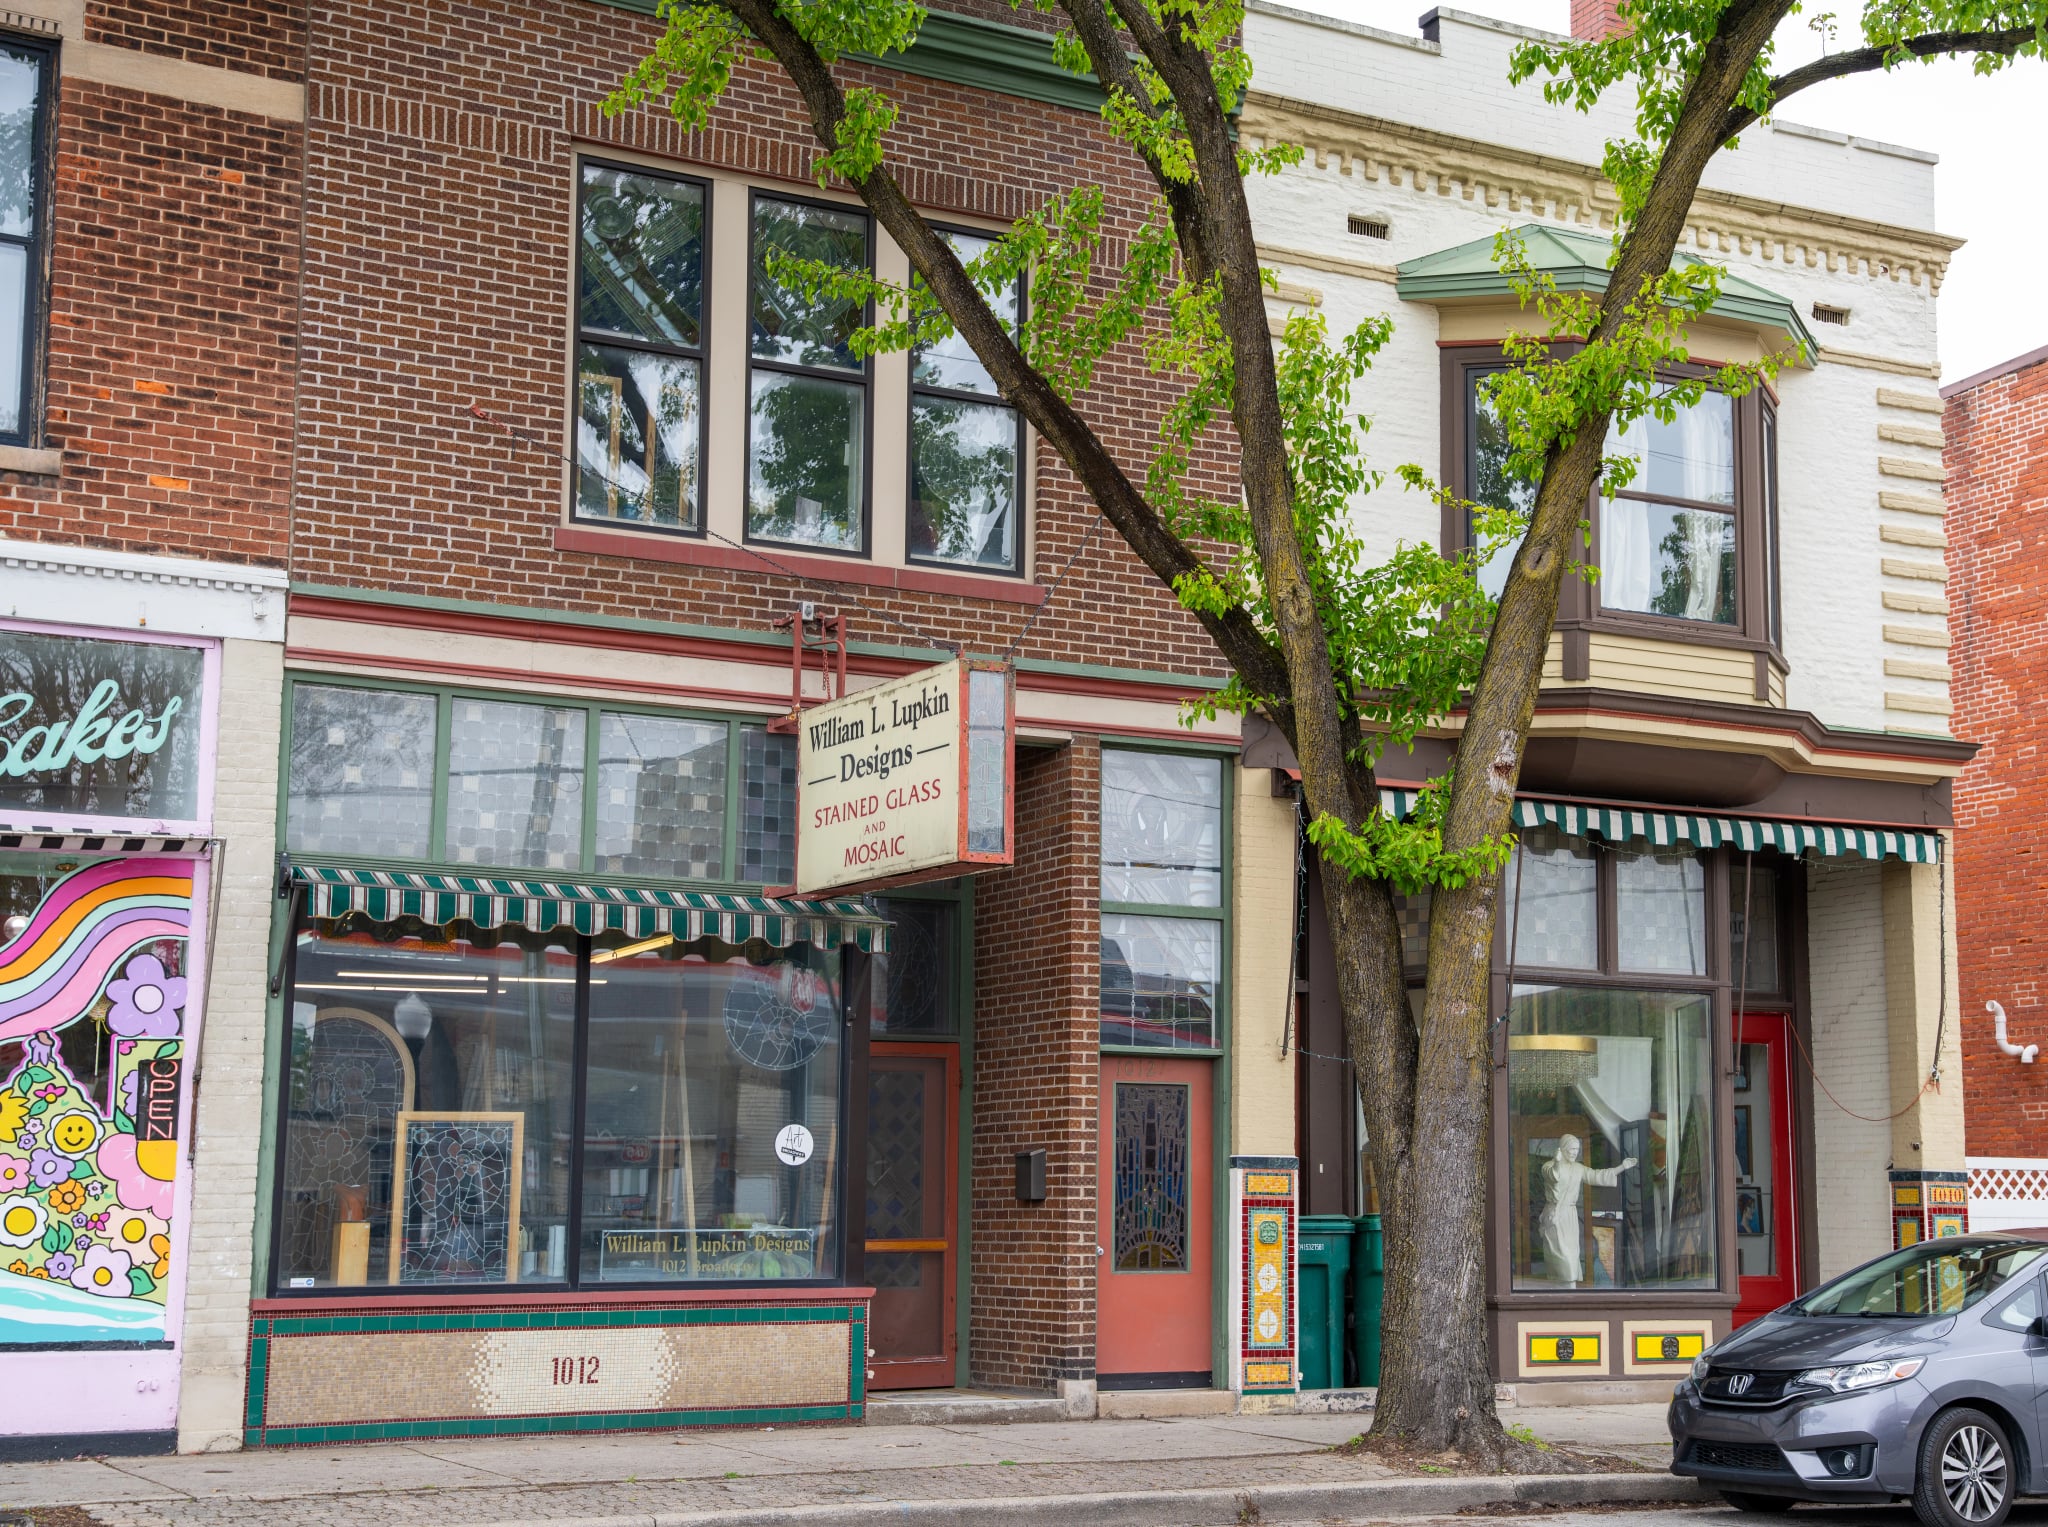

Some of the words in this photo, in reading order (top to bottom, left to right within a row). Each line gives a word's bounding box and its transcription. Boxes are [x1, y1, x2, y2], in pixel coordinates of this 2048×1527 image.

[809, 715, 865, 753] William
[871, 706, 886, 735] L.
[892, 685, 950, 730] Lupkin
[840, 744, 913, 780] Designs
[814, 795, 879, 829] STAINED
[886, 778, 942, 810] GLASS
[864, 820, 886, 835] AND
[844, 835, 905, 868] MOSAIC
[147, 1060, 179, 1141] OPEN
[785, 1126, 805, 1150] Art
[607, 1234, 666, 1254] William
[672, 1235, 687, 1253] L.
[694, 1234, 747, 1257] Lupkin
[754, 1234, 811, 1256] Designs
[661, 1259, 686, 1274] 1012
[551, 1356, 600, 1386] 1012
